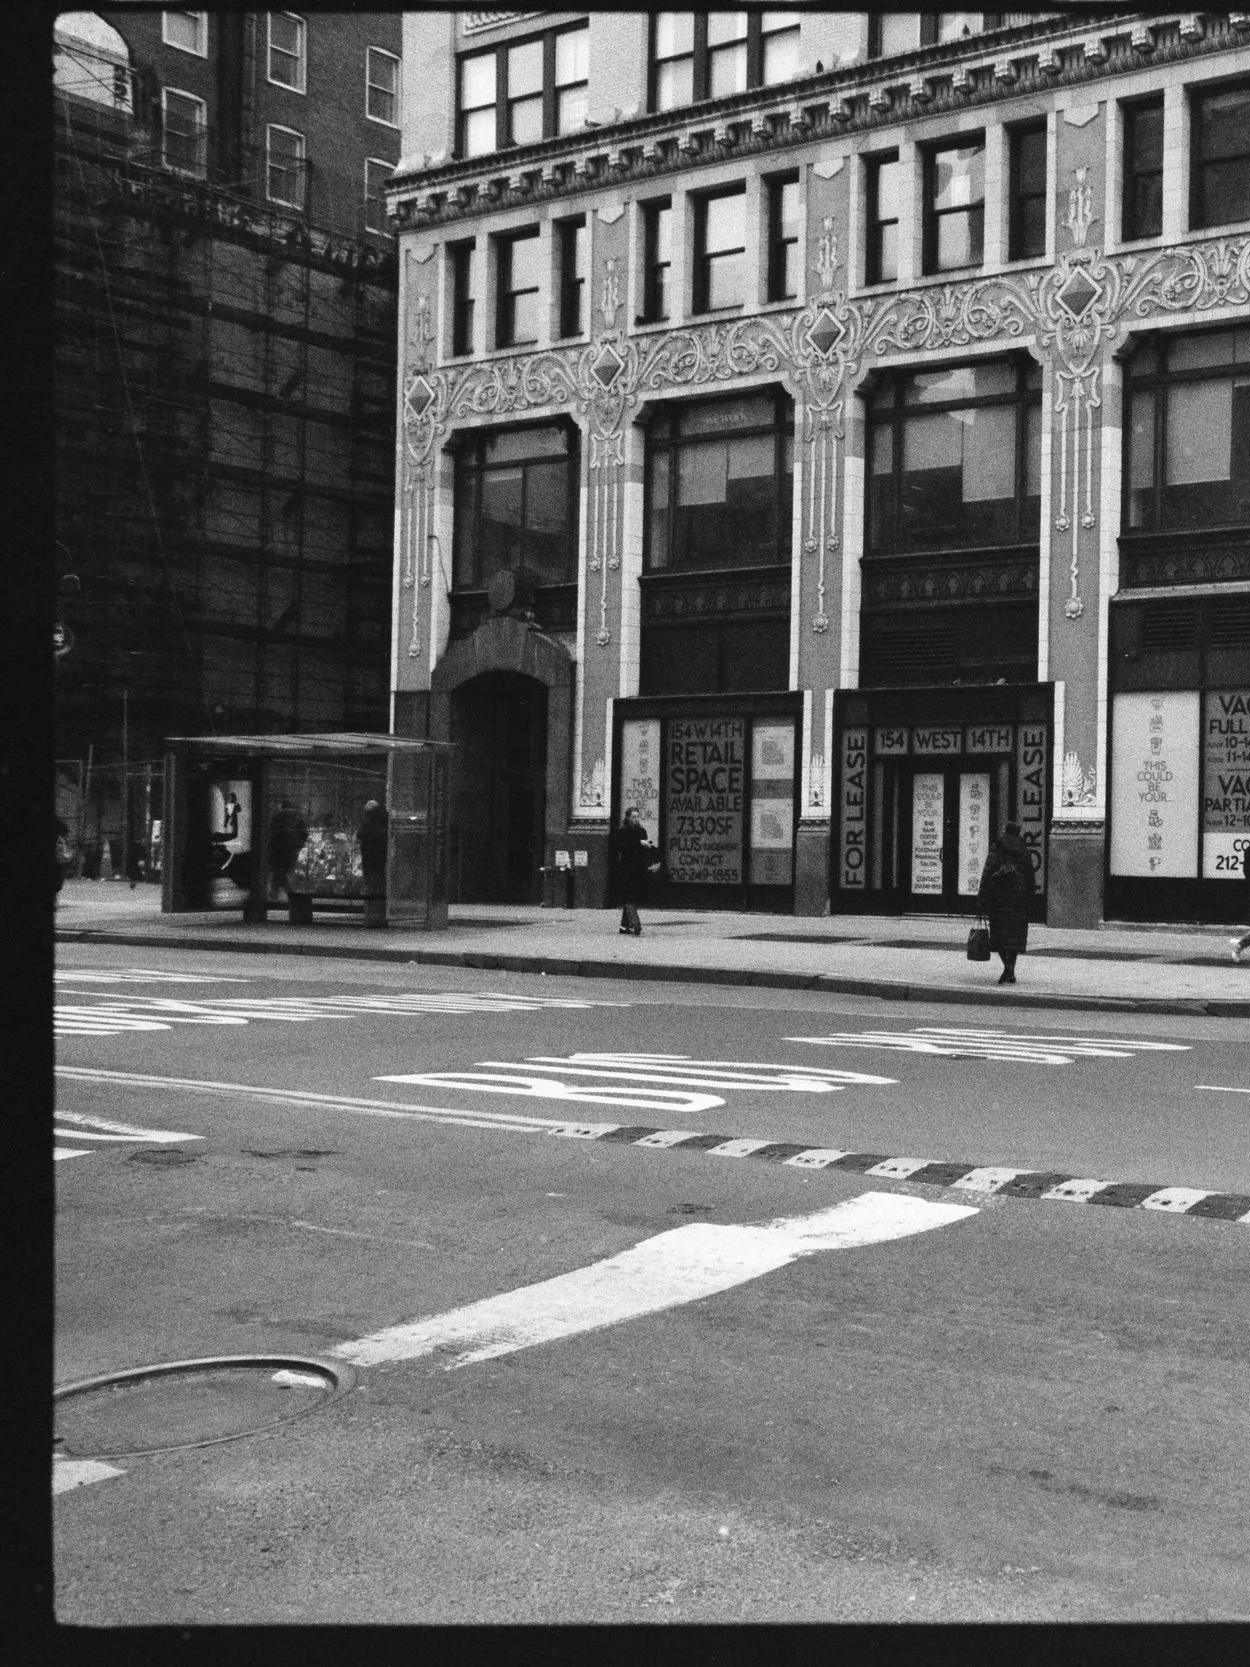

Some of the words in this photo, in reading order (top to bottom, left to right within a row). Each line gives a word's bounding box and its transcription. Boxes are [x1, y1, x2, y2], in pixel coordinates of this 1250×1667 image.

[671, 724, 692, 739] 154
[693, 724, 709, 738] W
[710, 722, 743, 738] 14TH
[1209, 718, 1249, 734] FULL
[880, 732, 904, 749] 154
[916, 730, 961, 749] WEST
[970, 729, 1010, 748] 14TH
[671, 742, 742, 765] RETAIL
[1143, 760, 1168, 771] THIS
[631, 777, 653, 790] THIS
[670, 767, 742, 795] SPACE
[846, 735, 866, 823] LEASE
[1022, 731, 1044, 823] LEASE
[1137, 770, 1174, 782] COULD
[625, 789, 658, 800] COULD
[1148, 781, 1162, 792] BE
[669, 796, 742, 813] AVAILABLE
[670, 837, 702, 852] PLUS
[679, 854, 723, 866] CONTACT
[845, 829, 864, 886] FOR
[780, 1027, 1194, 1065] BUS
[370, 1051, 901, 1113] BUS
